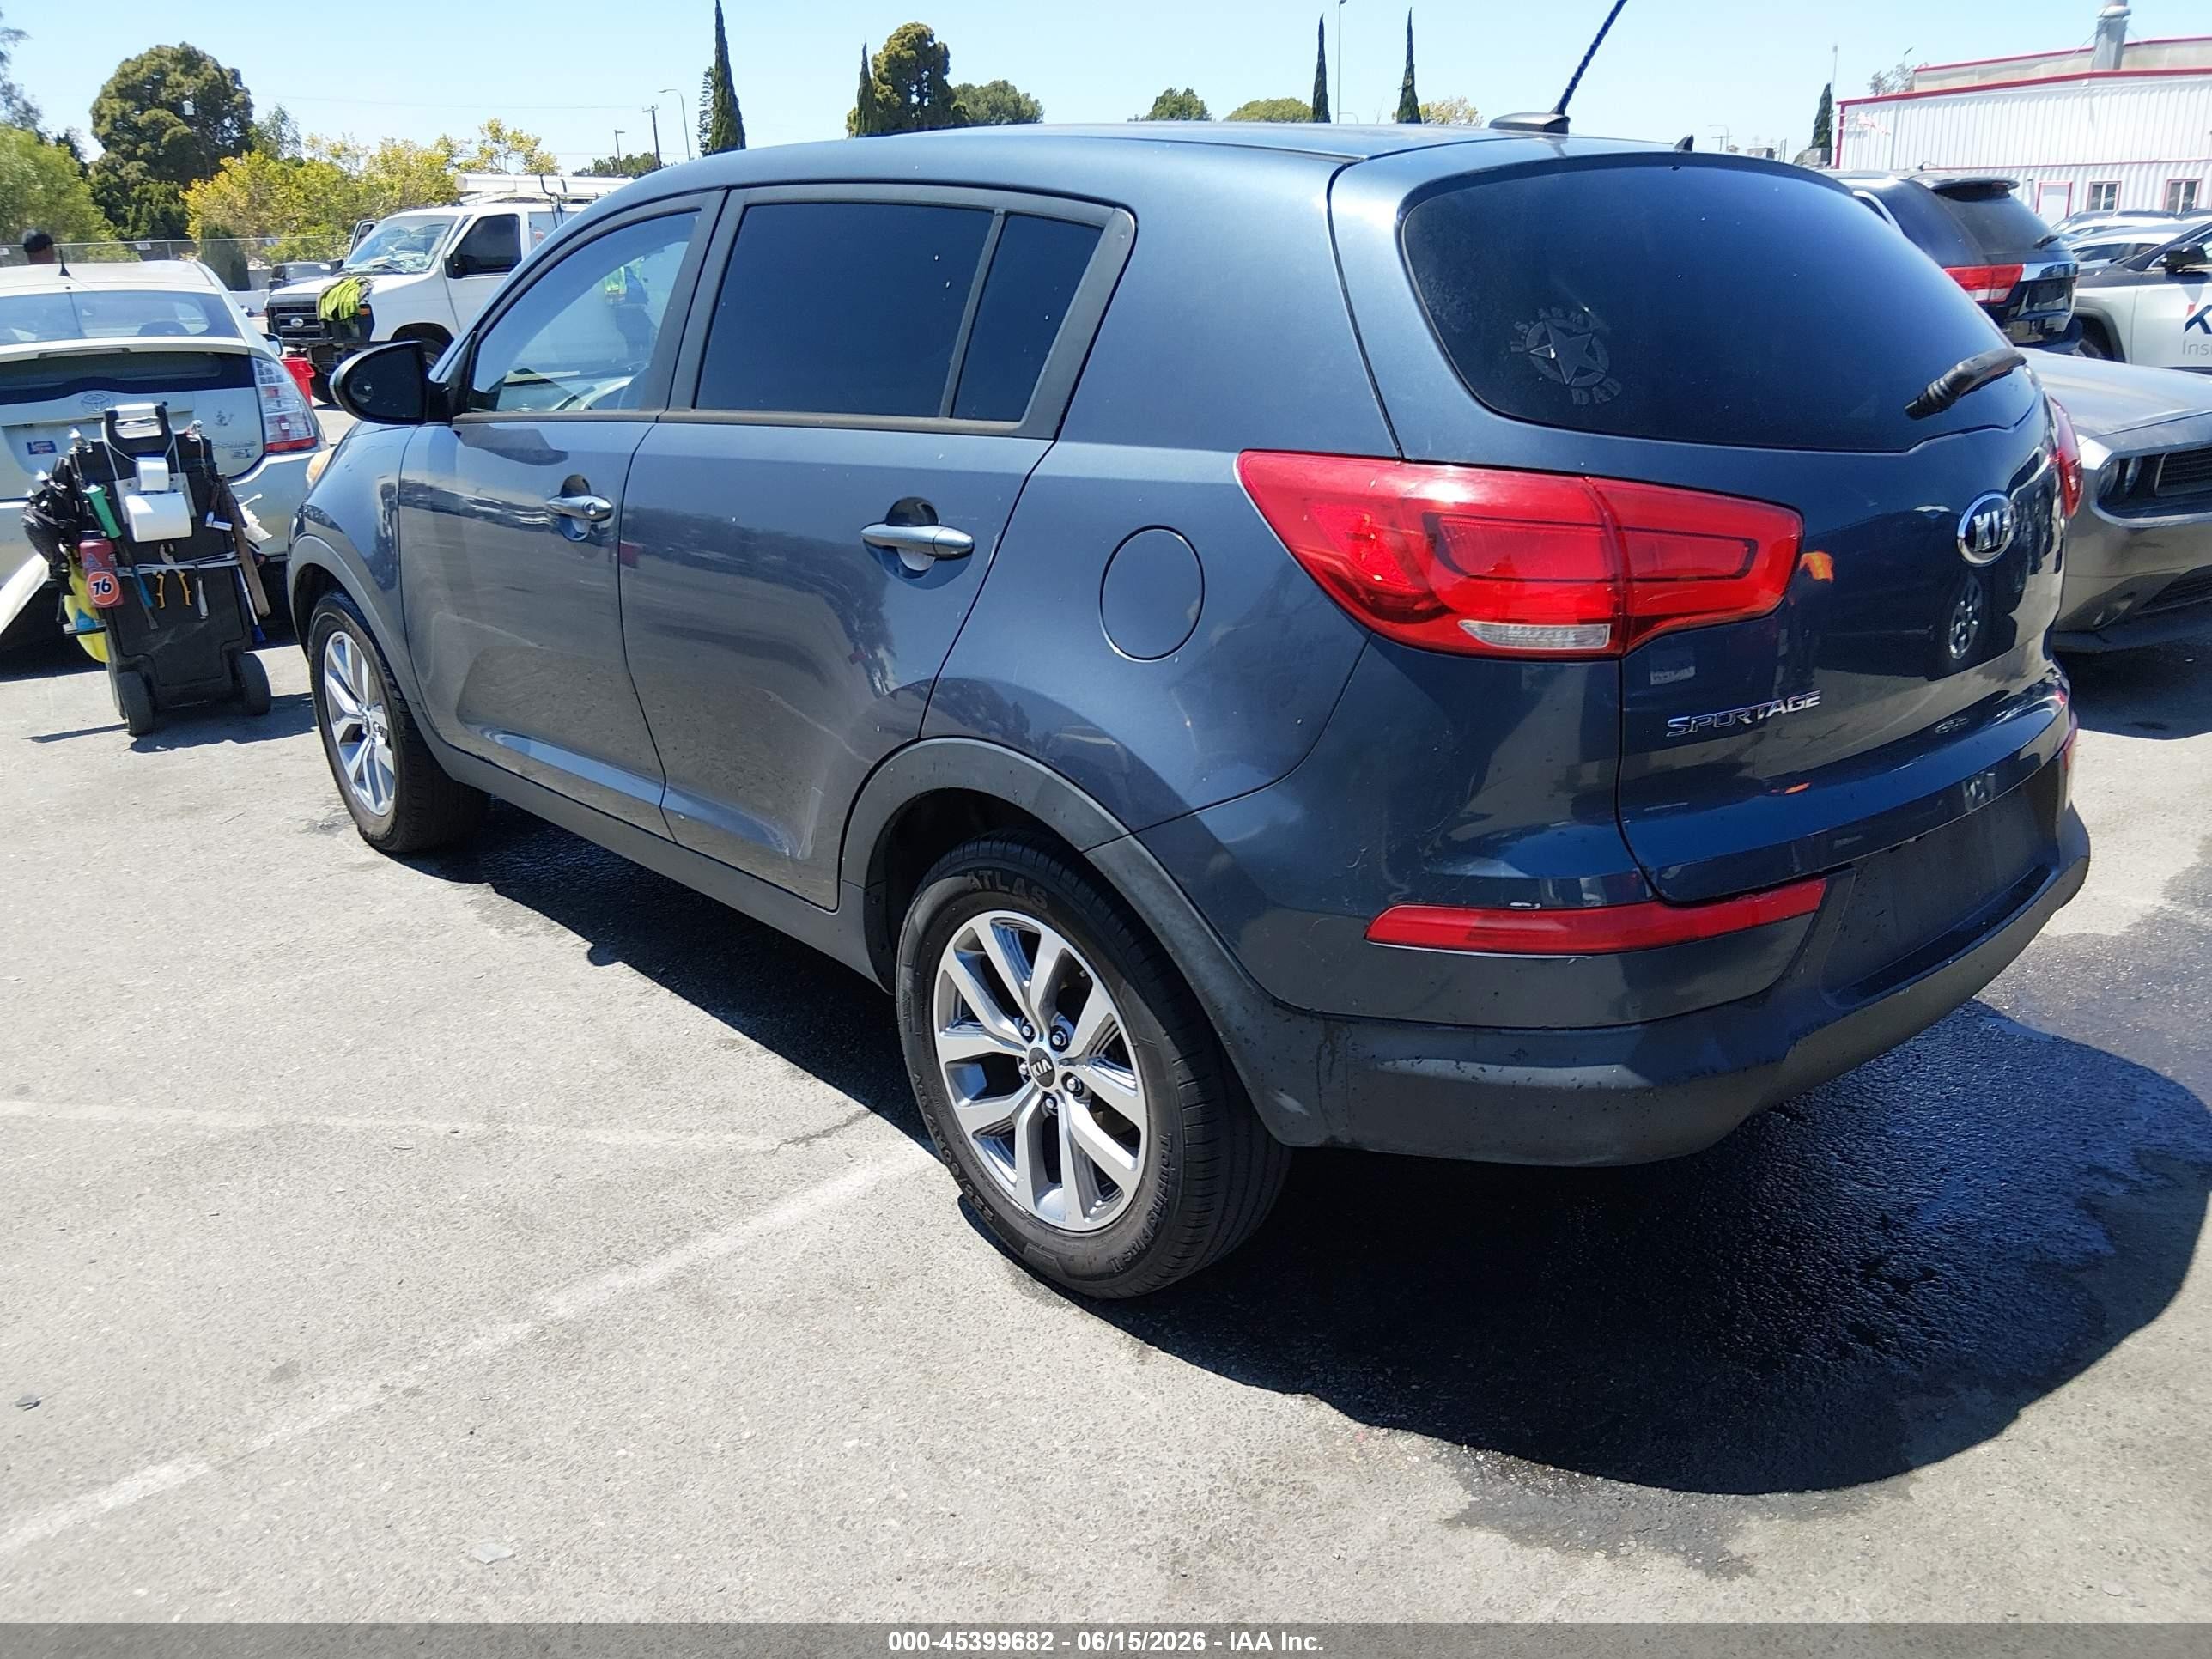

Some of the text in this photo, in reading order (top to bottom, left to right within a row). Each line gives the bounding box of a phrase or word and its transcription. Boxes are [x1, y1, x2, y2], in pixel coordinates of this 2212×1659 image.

[2183, 339, 2212, 356] Ins
[91, 577, 112, 596] 76
[1666, 690, 1821, 737] SPORTAGE
[967, 870, 1048, 910] ATLAS
[1031, 1059, 1052, 1077] KIA
